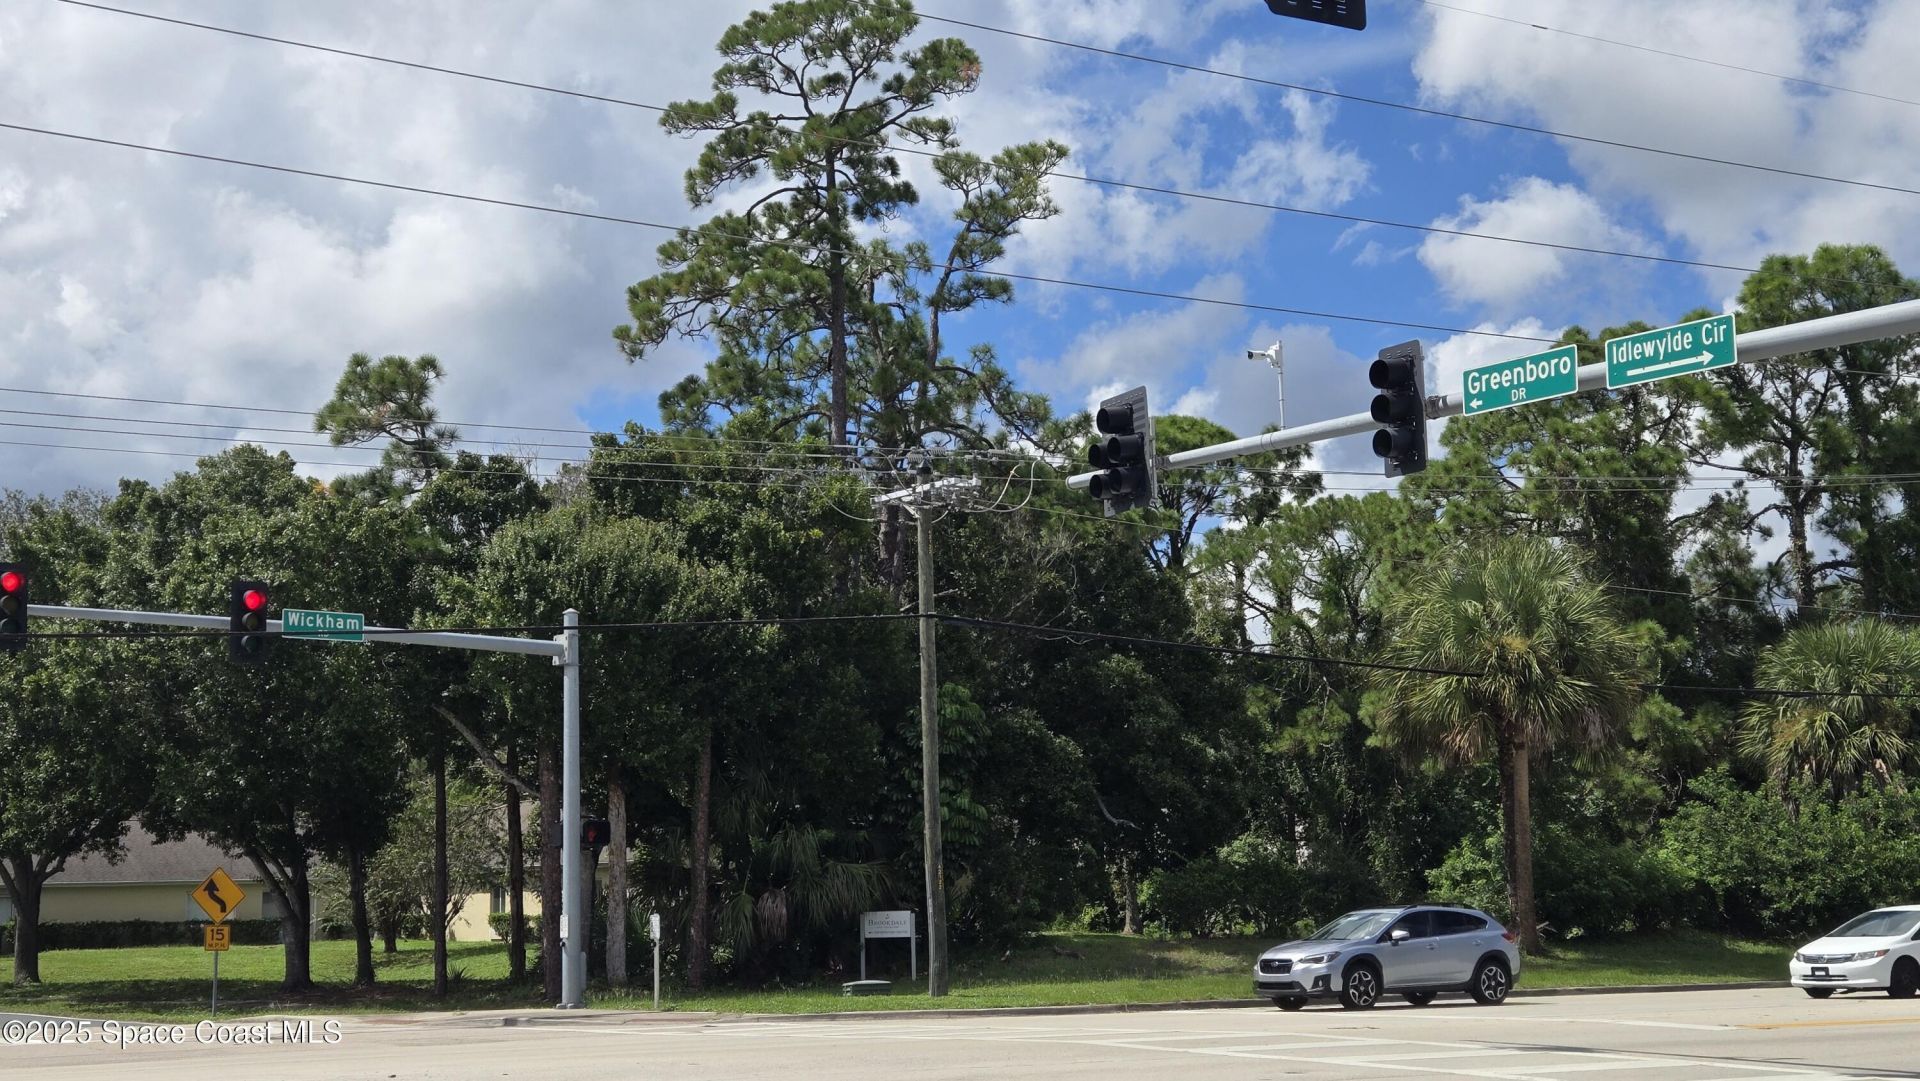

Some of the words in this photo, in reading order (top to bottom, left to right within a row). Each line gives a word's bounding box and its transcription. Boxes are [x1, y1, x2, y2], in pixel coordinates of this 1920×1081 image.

[1612, 329, 1693, 365] Idlewylde
[1701, 321, 1727, 346] Cir
[1467, 356, 1571, 395] Greenboro
[1511, 387, 1527, 401] DR
[288, 611, 360, 630] Wickham
[210, 928, 225, 941] 15
